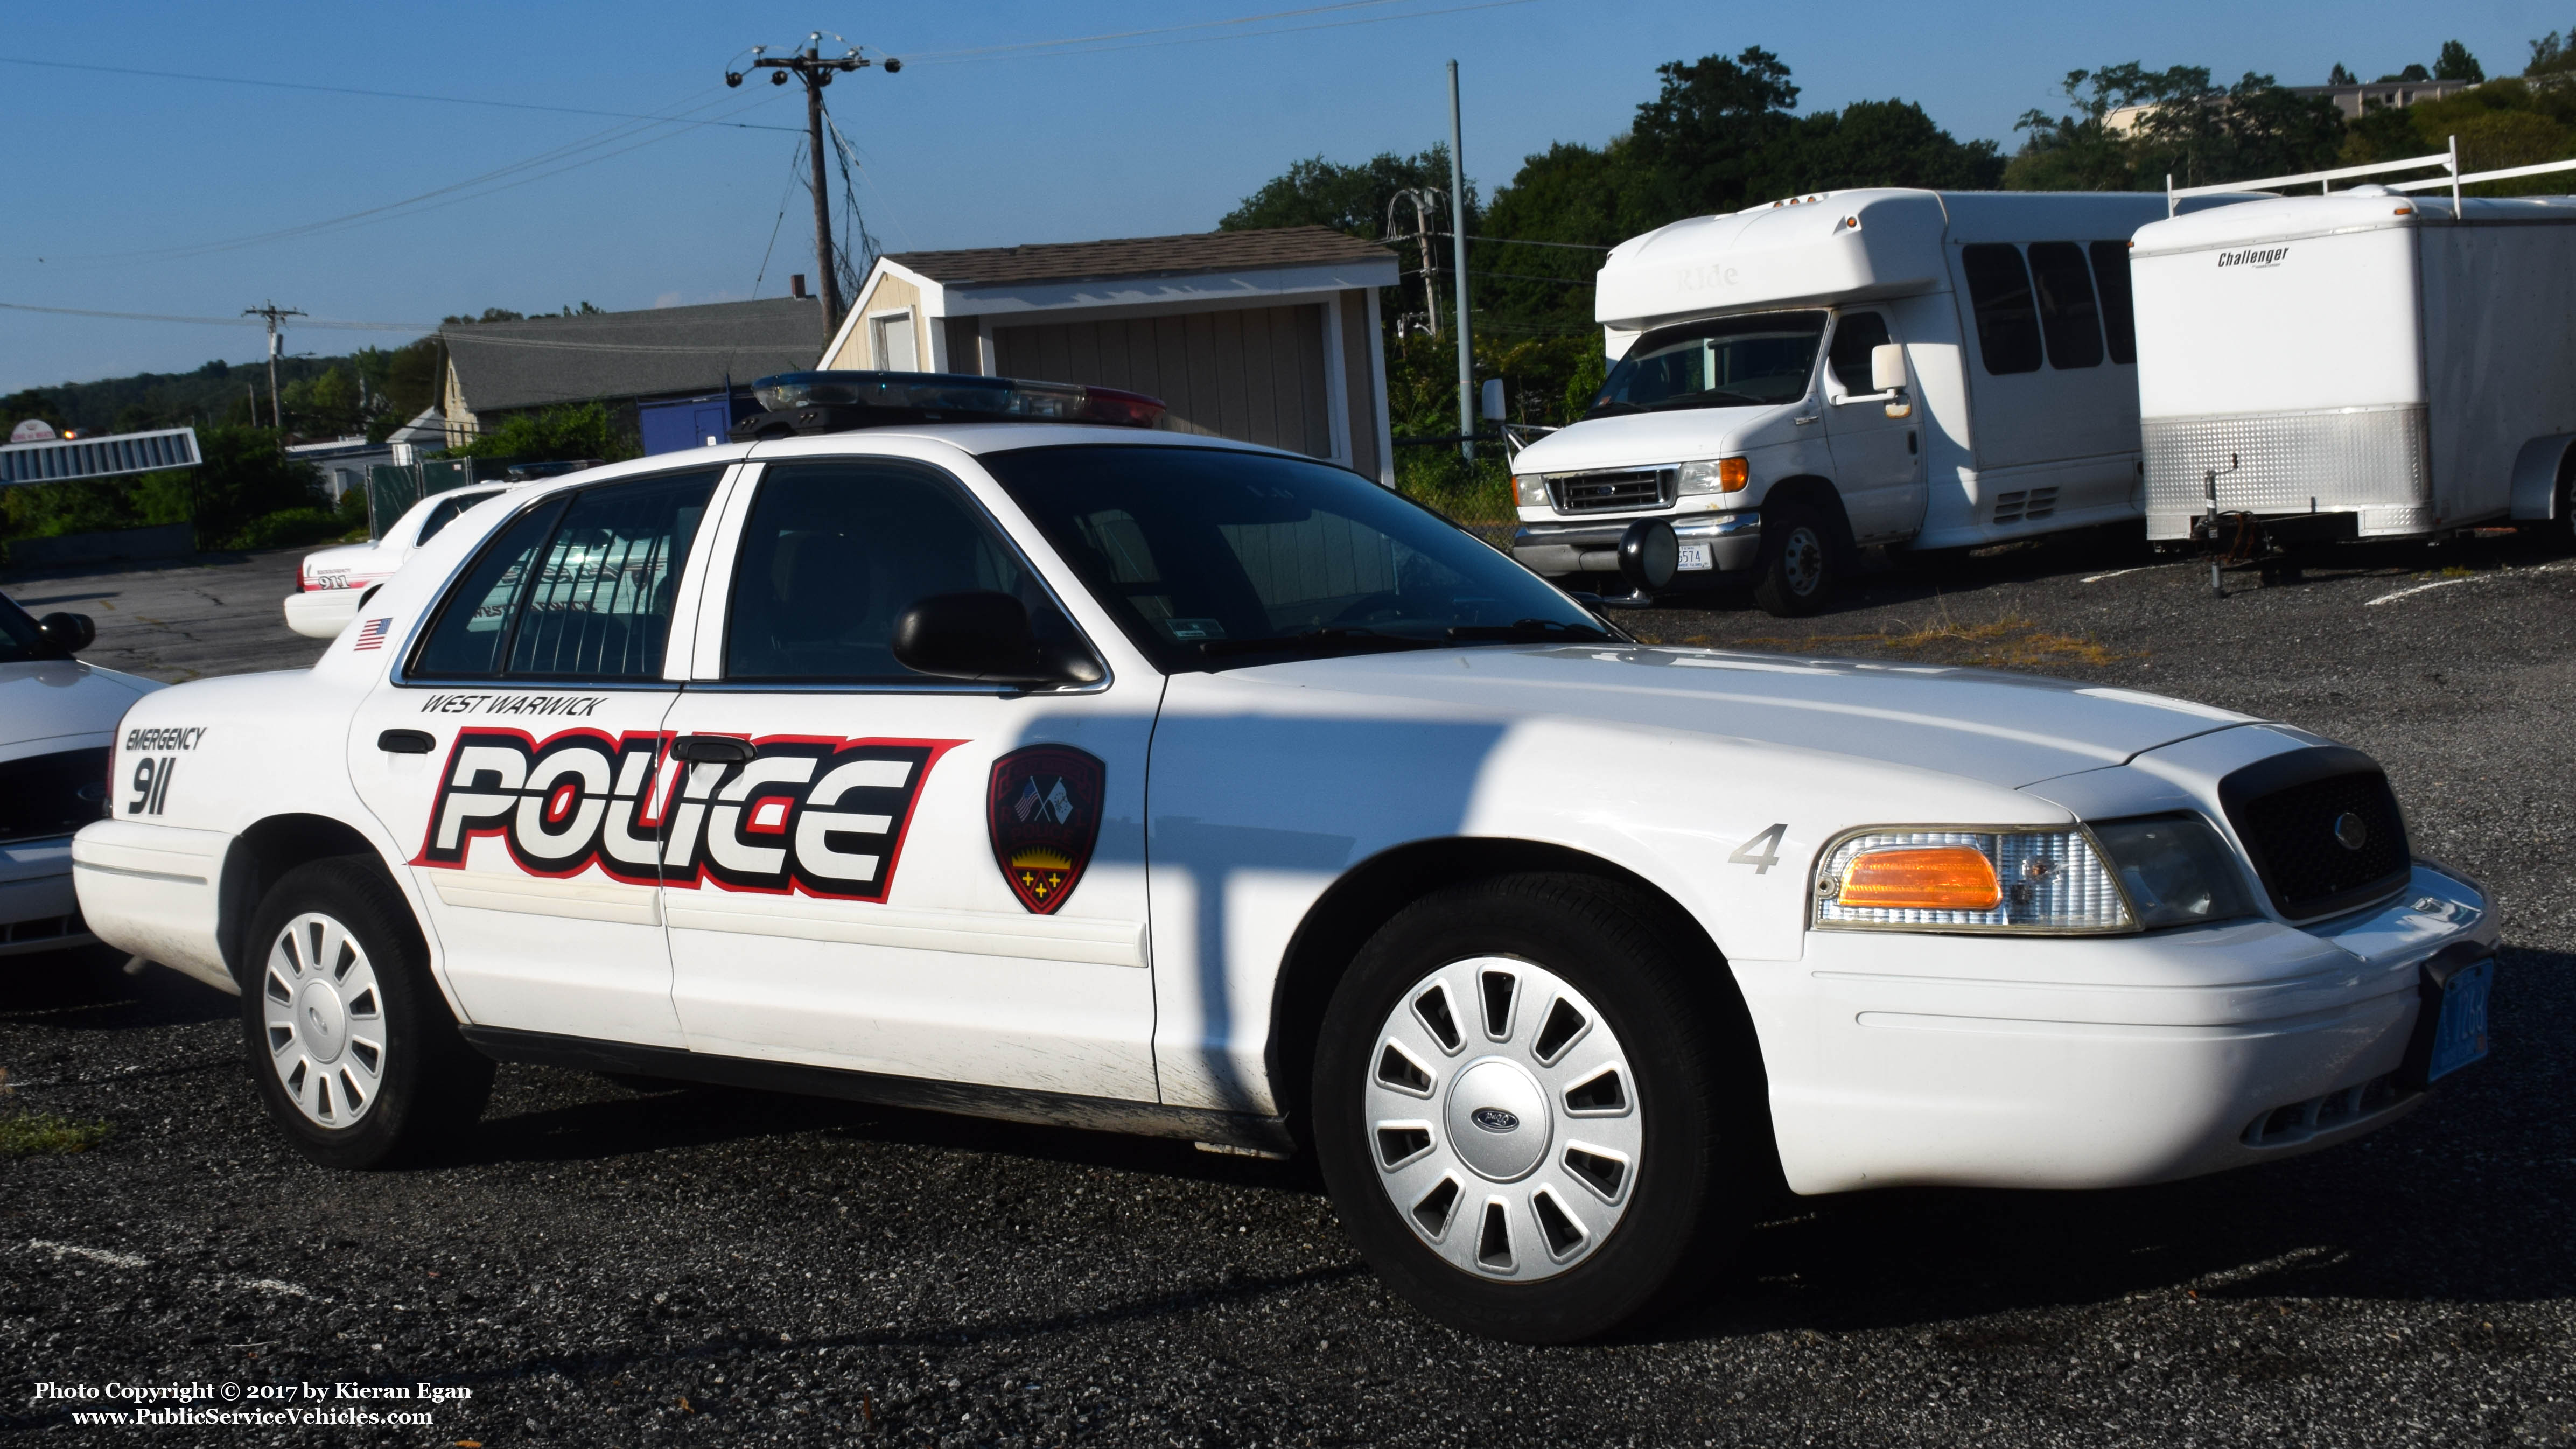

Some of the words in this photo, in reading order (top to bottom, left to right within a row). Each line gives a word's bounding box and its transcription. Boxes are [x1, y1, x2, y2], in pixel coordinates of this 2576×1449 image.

[2218, 247, 2289, 267] Challenger
[318, 575, 351, 590] 911
[421, 695, 487, 713] WEST
[485, 697, 609, 716] WARWICK
[126, 727, 207, 751] EMERGENCY
[128, 757, 176, 815] 911
[425, 736, 934, 894] POLICE
[1011, 824, 1075, 842] POLICE
[1727, 823, 1788, 875] 4
[1485, 1112, 1509, 1126] Ford
